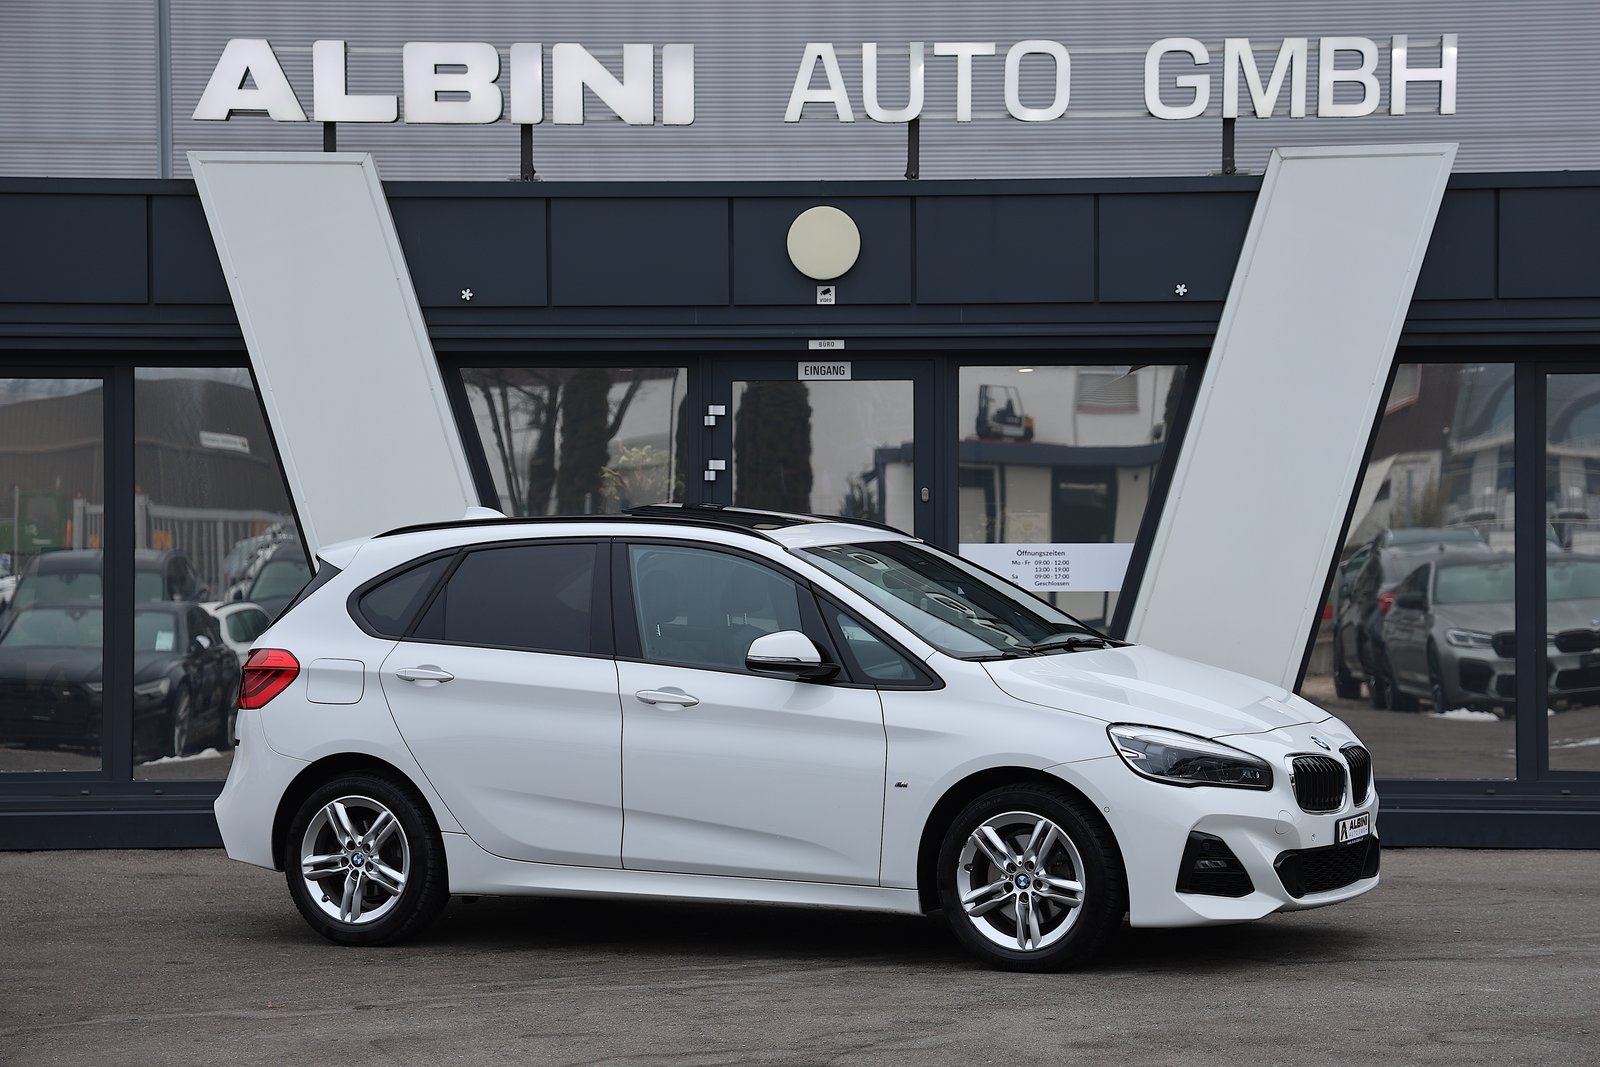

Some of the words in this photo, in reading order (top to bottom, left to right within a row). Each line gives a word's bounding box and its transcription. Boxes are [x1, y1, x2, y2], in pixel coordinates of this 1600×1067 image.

[192, 38, 695, 126] ALBINI
[784, 40, 1071, 123] AUTO
[1144, 33, 1459, 120] GMBH
[804, 365, 846, 376] EINGANG
